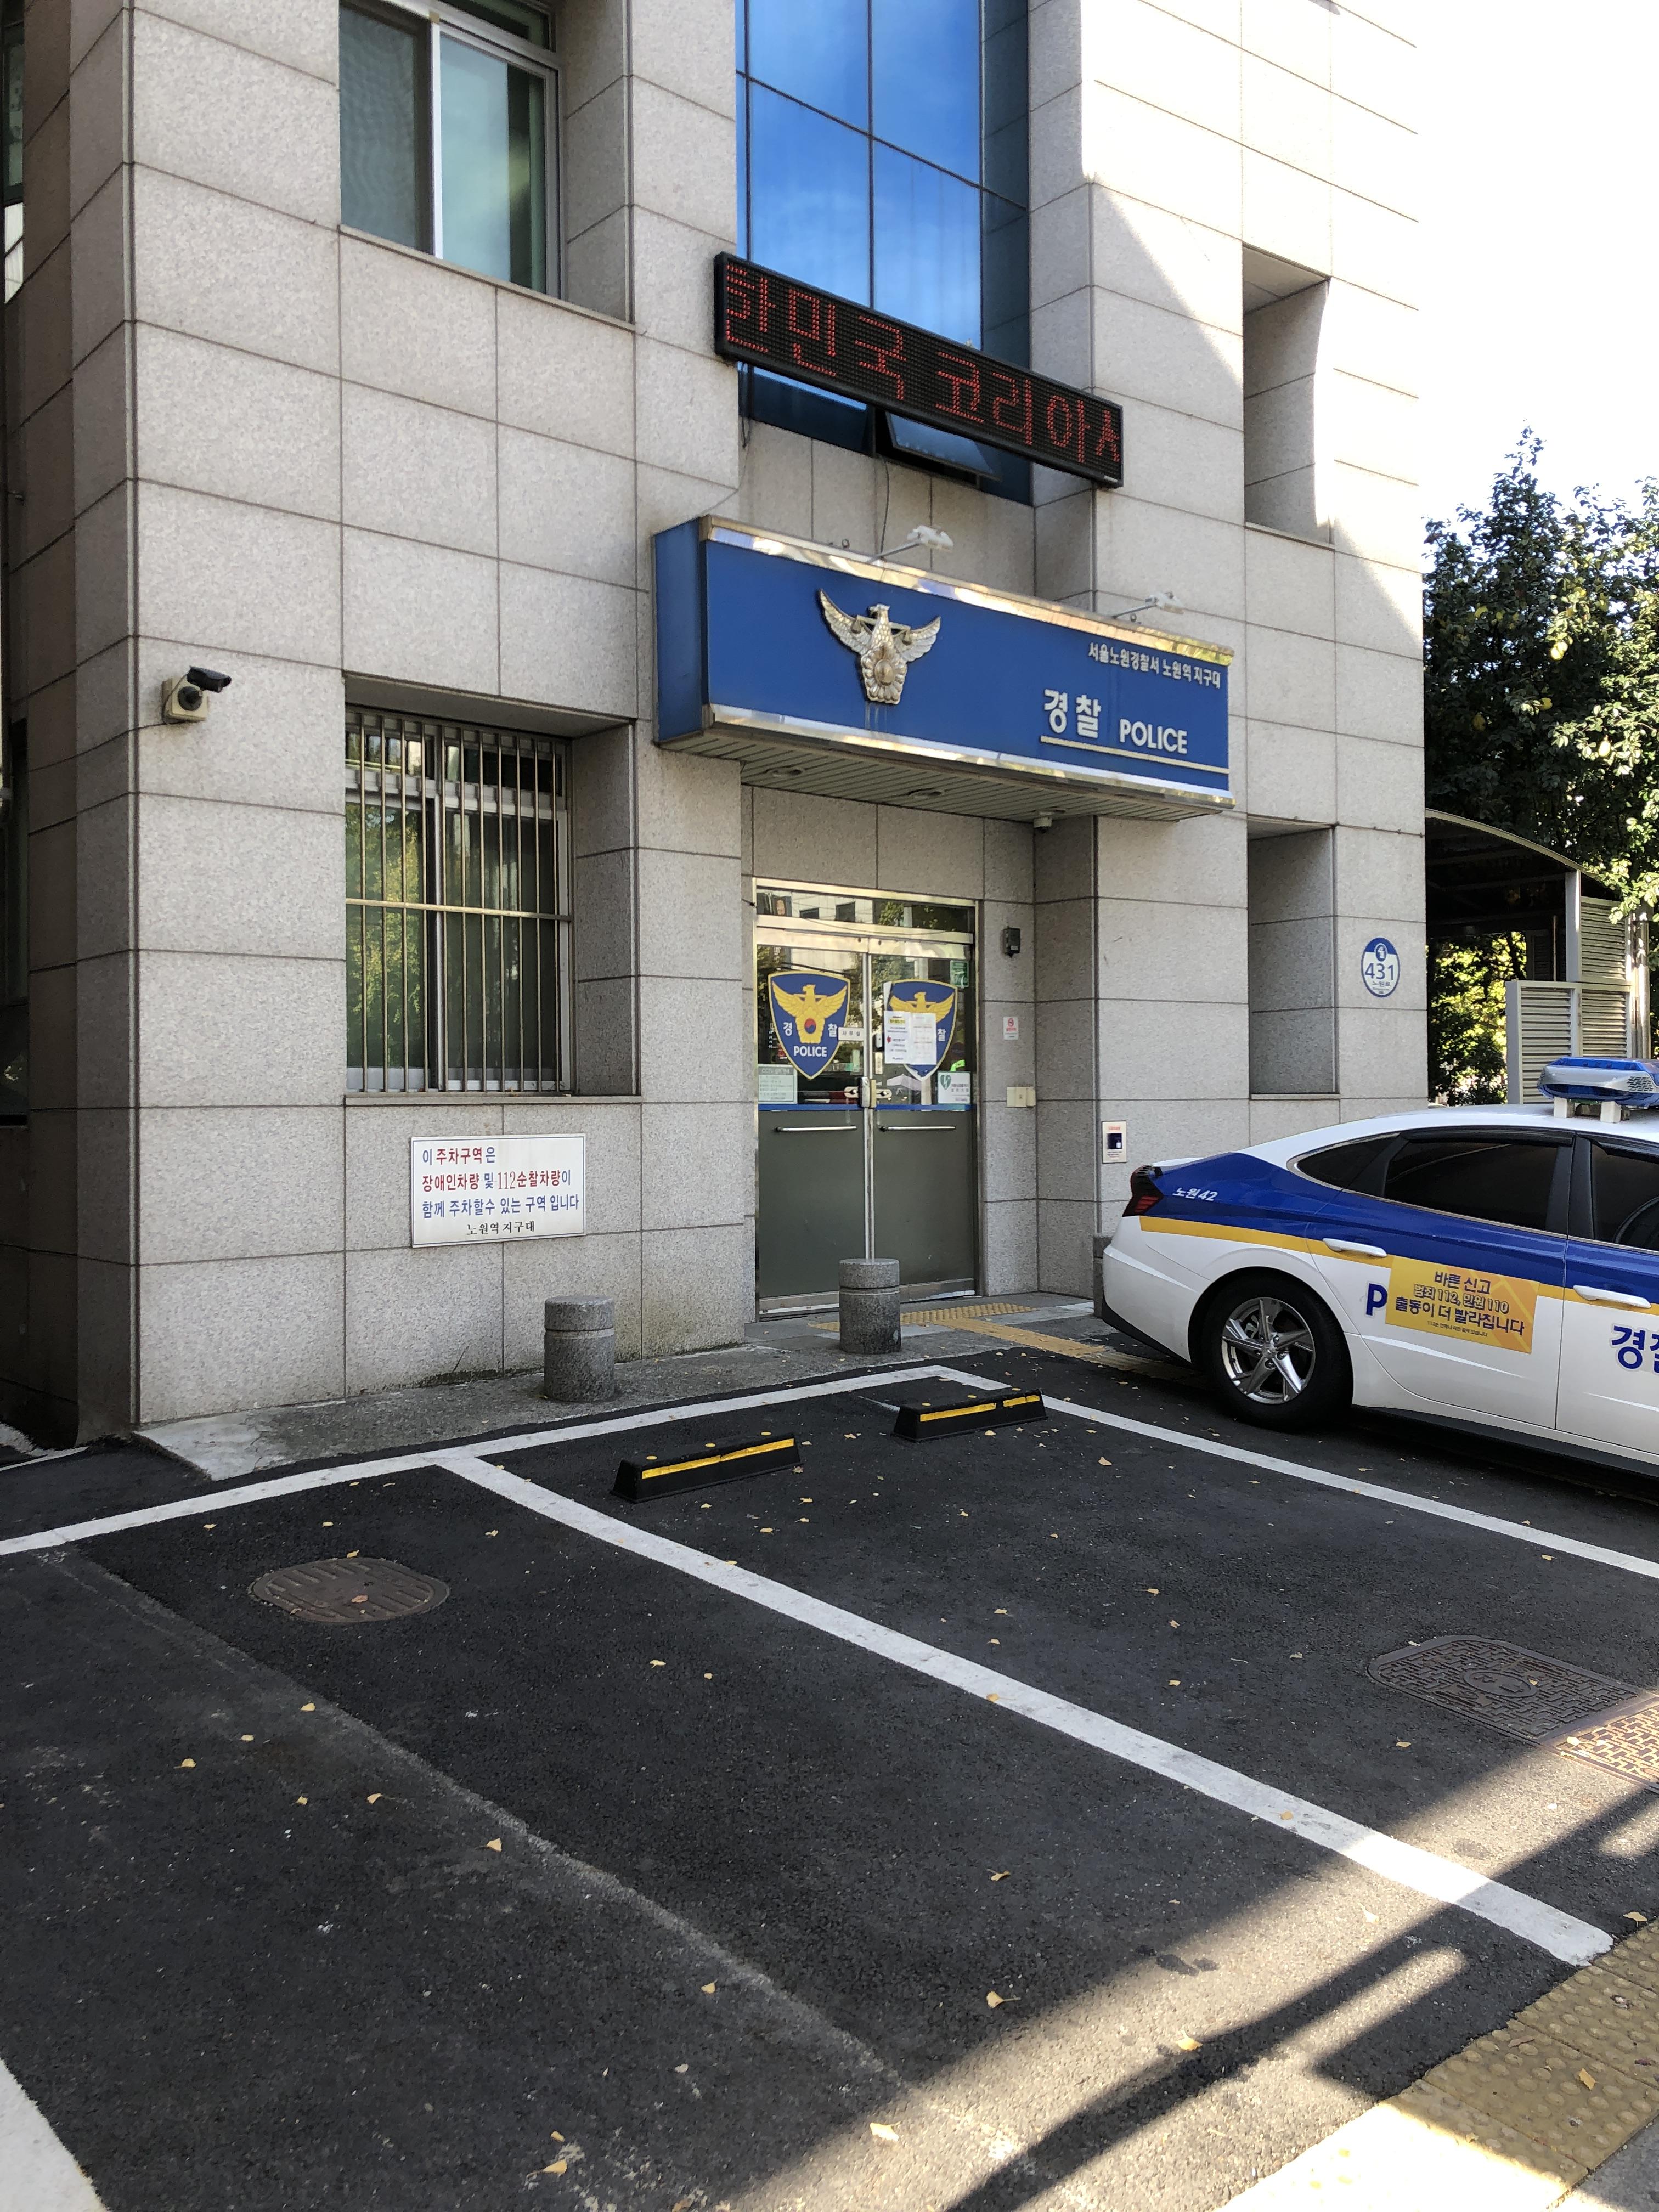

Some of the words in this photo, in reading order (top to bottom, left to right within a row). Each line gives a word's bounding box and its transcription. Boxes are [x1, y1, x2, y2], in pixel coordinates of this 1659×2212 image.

[1088, 642, 1159, 674] 서울노원경찰서
[1163, 659, 1192, 682] 노원역
[1194, 666, 1221, 689] 지구대
[1045, 689, 1101, 738] 경찰
[1119, 718, 1188, 754] POLICE
[1365, 963, 1394, 980] 431
[793, 1045, 827, 1057] POLICE
[423, 1149, 432, 1165] 이
[422, 1173, 479, 1192] 장애인차량
[484, 1172, 494, 1189] 및
[498, 1169, 571, 1190] 112순찰차량이
[422, 1200, 445, 1218] 함께
[449, 1198, 495, 1217] 주차할수
[500, 1197, 521, 1214] 있는
[466, 1222, 499, 1235] 노원역
[503, 1220, 535, 1233] 지구대
[1434, 1271, 1462, 1289] 바른
[1464, 1277, 1491, 1294] 신고
[1414, 1283, 1435, 1301] 범죄
[1463, 1293, 1486, 1310] 민원
[1488, 1298, 1509, 1314] 110
[1396, 1296, 1435, 1318] 출동이
[1438, 1305, 1451, 1321] 더
[1455, 1308, 1525, 1336] 빨라집니다
[1612, 1325, 1659, 1373] 경
